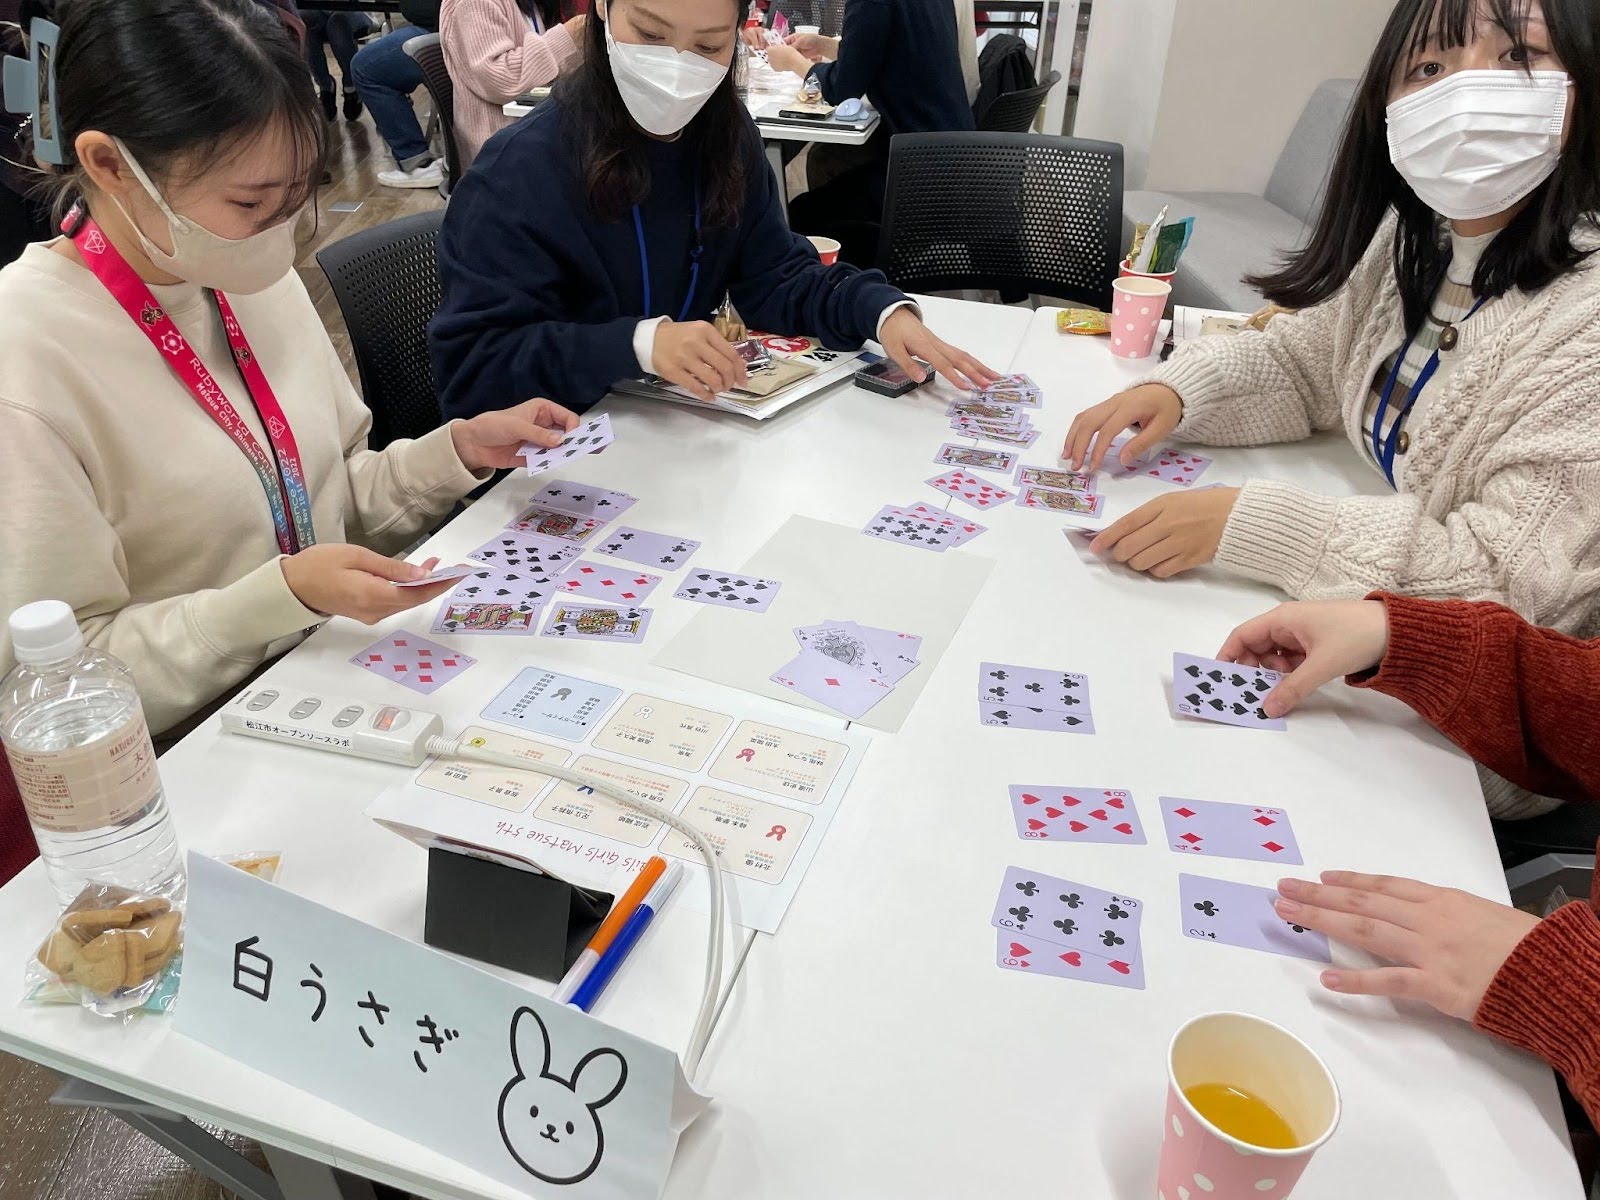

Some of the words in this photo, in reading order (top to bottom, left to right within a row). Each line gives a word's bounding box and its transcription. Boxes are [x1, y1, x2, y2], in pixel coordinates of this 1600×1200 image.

[196, 382, 219, 411] Matsue
[219, 410, 233, 430] City,
[234, 429, 259, 465] Shimane,
[277, 447, 295, 487] 2022
[289, 457, 300, 478] 2022
[296, 482, 306, 506] 10-11
[290, 488, 307, 549] ference
[302, 507, 310, 524] Nov
[1264, 671, 1277, 681] 10
[1178, 703, 1191, 713] 10
[246, 719, 350, 747] 松江市オープンソースラボ
[109, 733, 136, 757] NATURAL
[495, 821, 524, 838] 5th
[526, 830, 583, 855] Matsue
[1174, 843, 1188, 851] 4
[585, 847, 619, 866] Girls
[621, 857, 648, 874] ails
[1122, 899, 1137, 908] 6
[999, 918, 1014, 928] 6
[1189, 927, 1205, 937] 2
[1002, 957, 1019, 967] 6
[233, 936, 459, 1073] 白うさぎ
